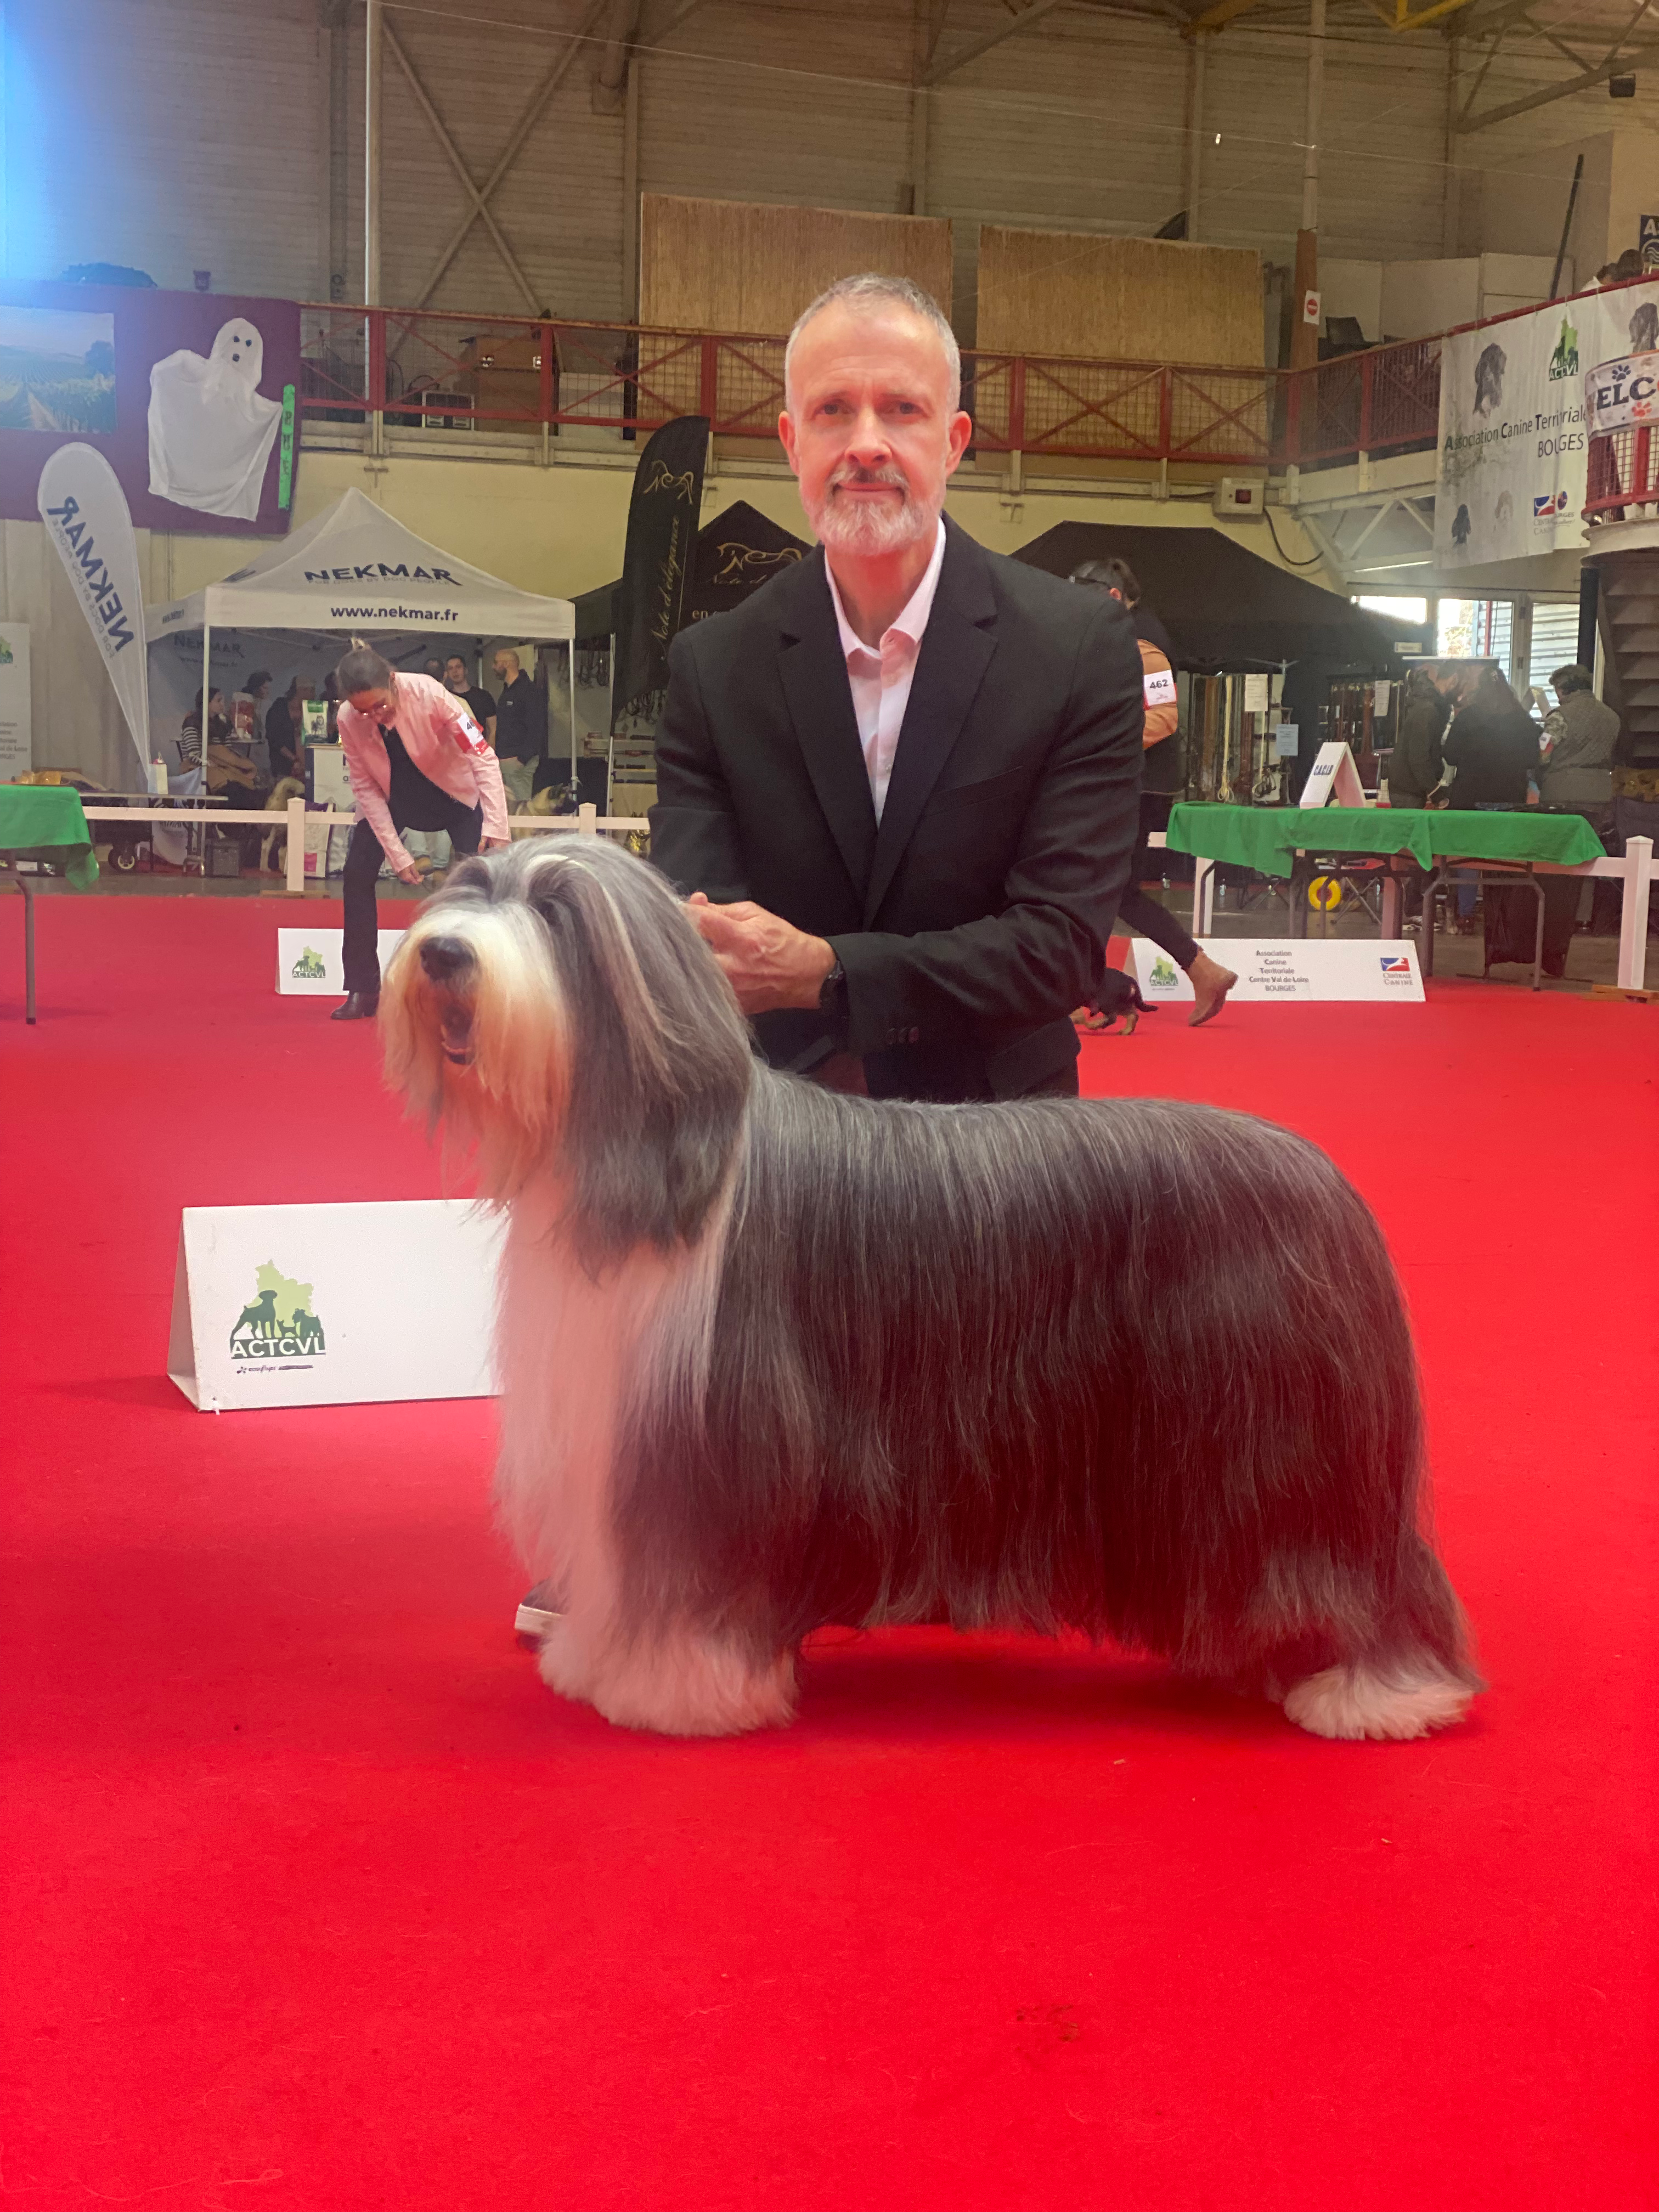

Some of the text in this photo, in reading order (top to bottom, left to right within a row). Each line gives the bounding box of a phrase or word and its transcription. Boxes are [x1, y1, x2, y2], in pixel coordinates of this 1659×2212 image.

[1596, 377, 1659, 410] ELC
[1502, 419, 1533, 439] Canine
[304, 563, 462, 586] NEKMAR
[330, 606, 459, 621] www.nekmar.fr
[1149, 679, 1169, 689] 462
[232, 1336, 326, 1358] ACTCVL
